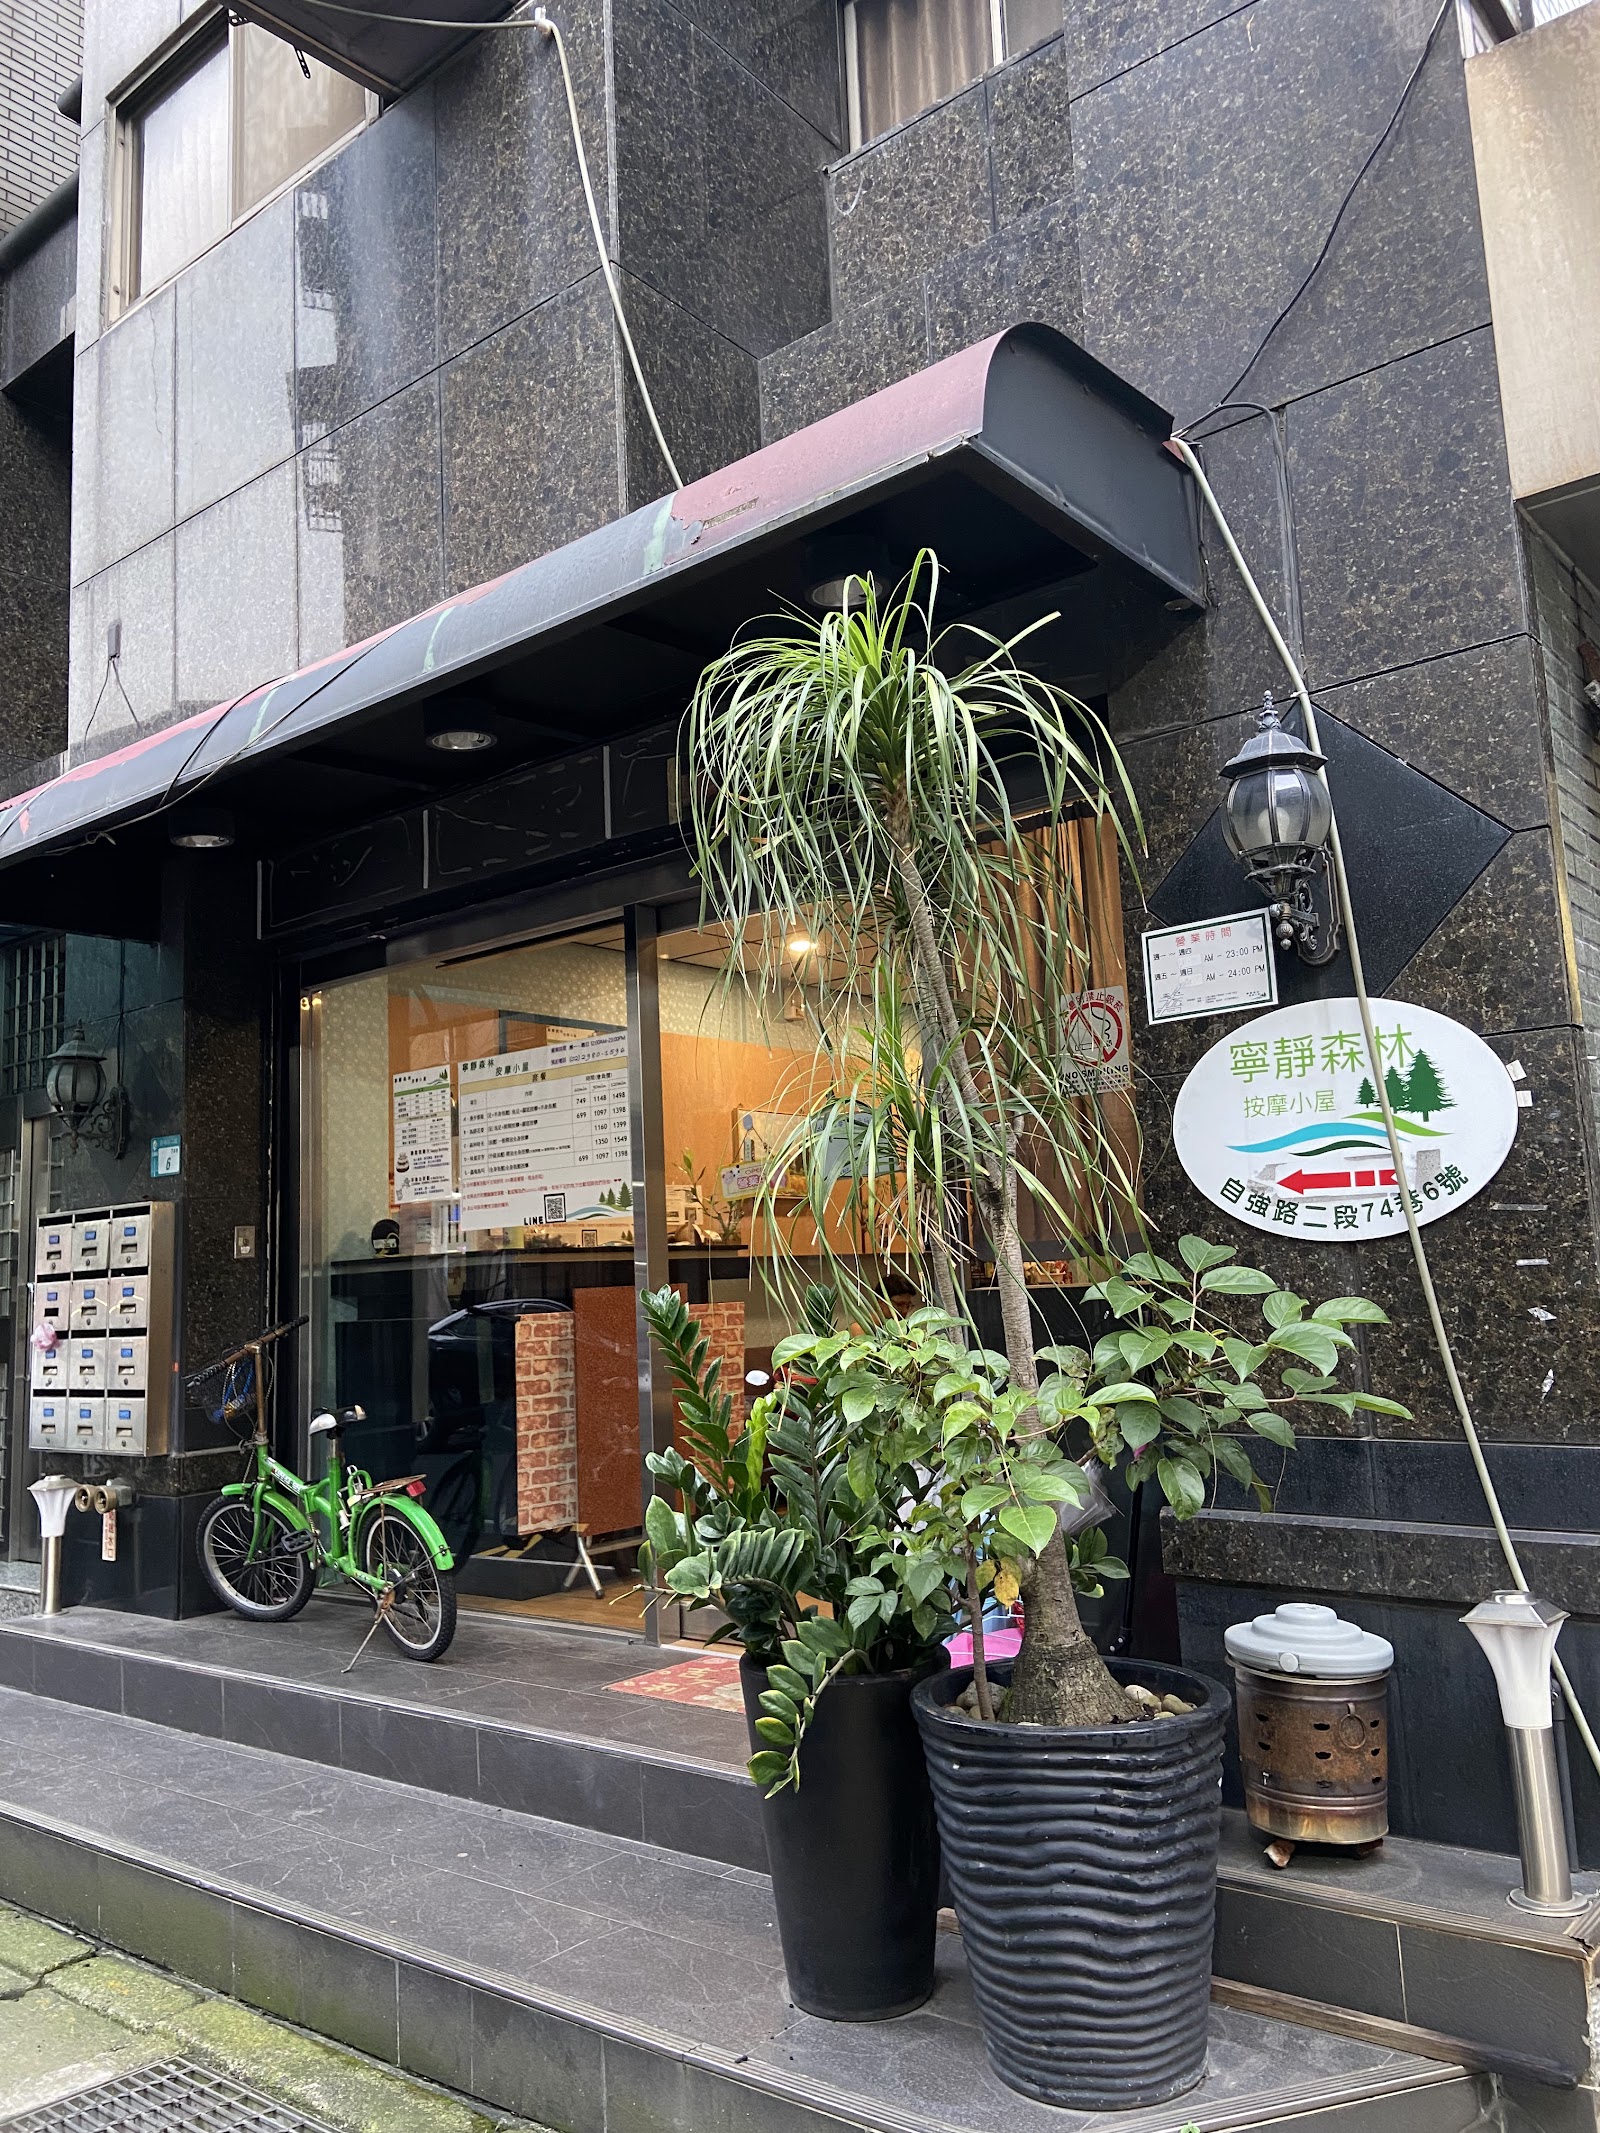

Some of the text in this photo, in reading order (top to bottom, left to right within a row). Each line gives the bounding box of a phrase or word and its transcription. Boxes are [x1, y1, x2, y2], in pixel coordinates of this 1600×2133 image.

[1175, 926, 1232, 947] 營業時間
[1204, 954, 1214, 963] AM
[1225, 946, 1249, 959] 23:00
[1252, 944, 1263, 953] PM
[1206, 973, 1216, 982] AM
[1228, 966, 1251, 978] 24:00
[1254, 963, 1266, 973] PM
[1229, 1023, 1415, 1084] 寧靜森林
[1066, 1064, 1128, 1079] NO SMKING
[613, 1106, 626, 1114] 1398
[1243, 1089, 1336, 1119] 按摩小屋
[614, 1135, 627, 1143] 1549
[165, 1157, 171, 1170] 6
[1219, 1164, 1469, 1230] 自強路二段74巷6號
[524, 1216, 543, 1226] LINE
